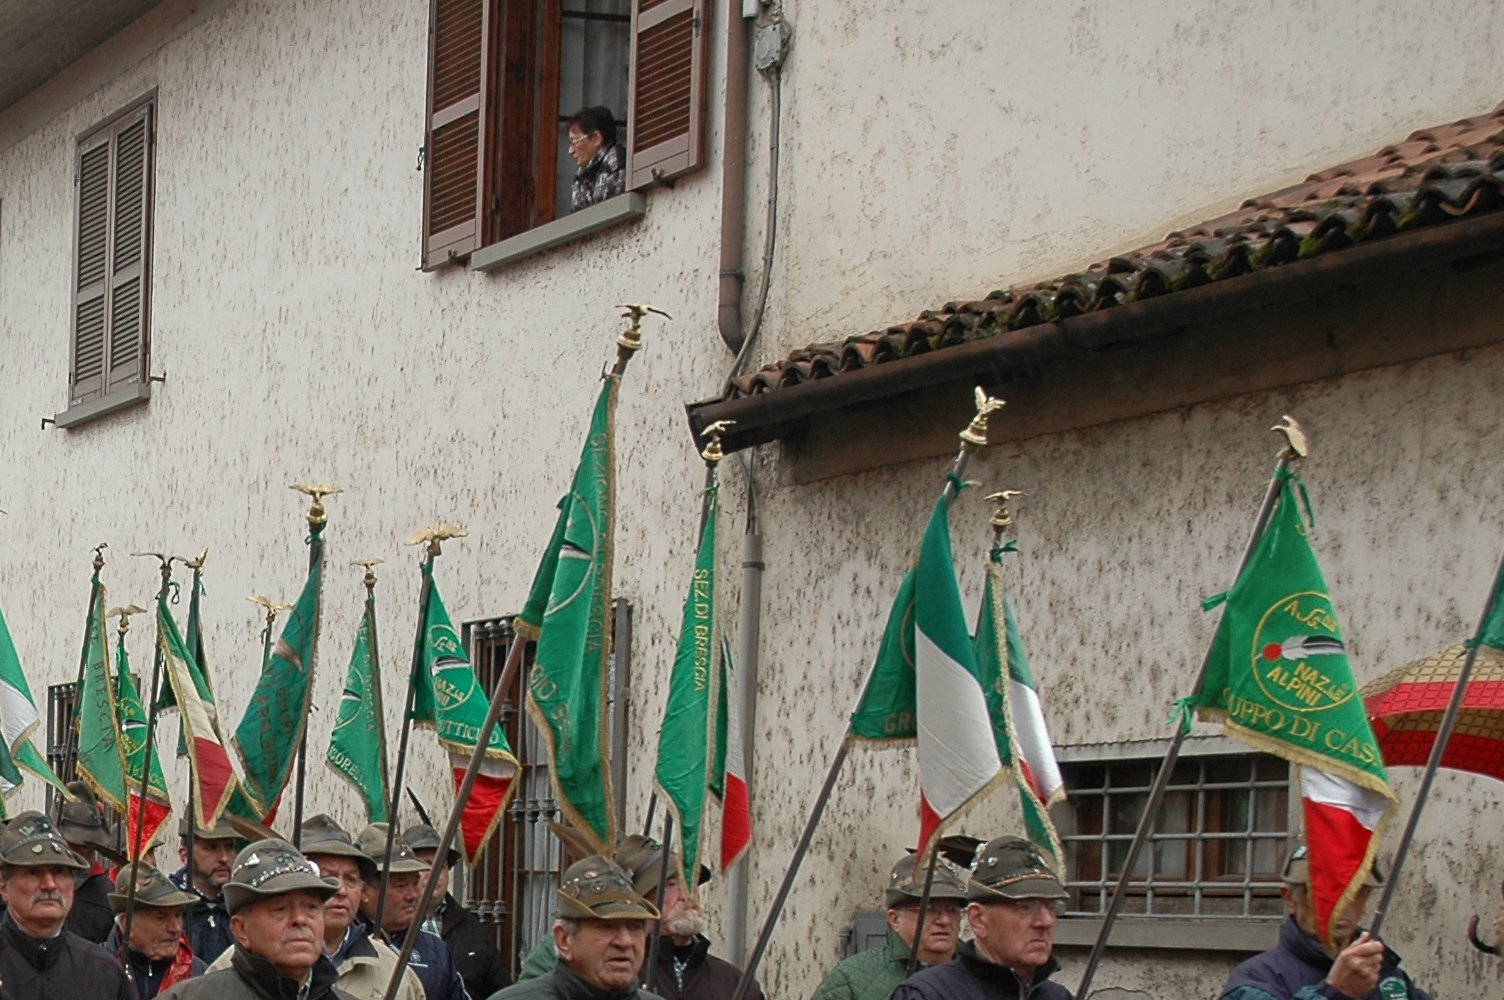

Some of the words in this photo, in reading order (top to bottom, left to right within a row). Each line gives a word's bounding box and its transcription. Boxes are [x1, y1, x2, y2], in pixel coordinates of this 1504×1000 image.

[693, 624, 709, 693] BRESCIA
[1266, 665, 1322, 707] ALPINI
[1288, 715, 1321, 743] DI
